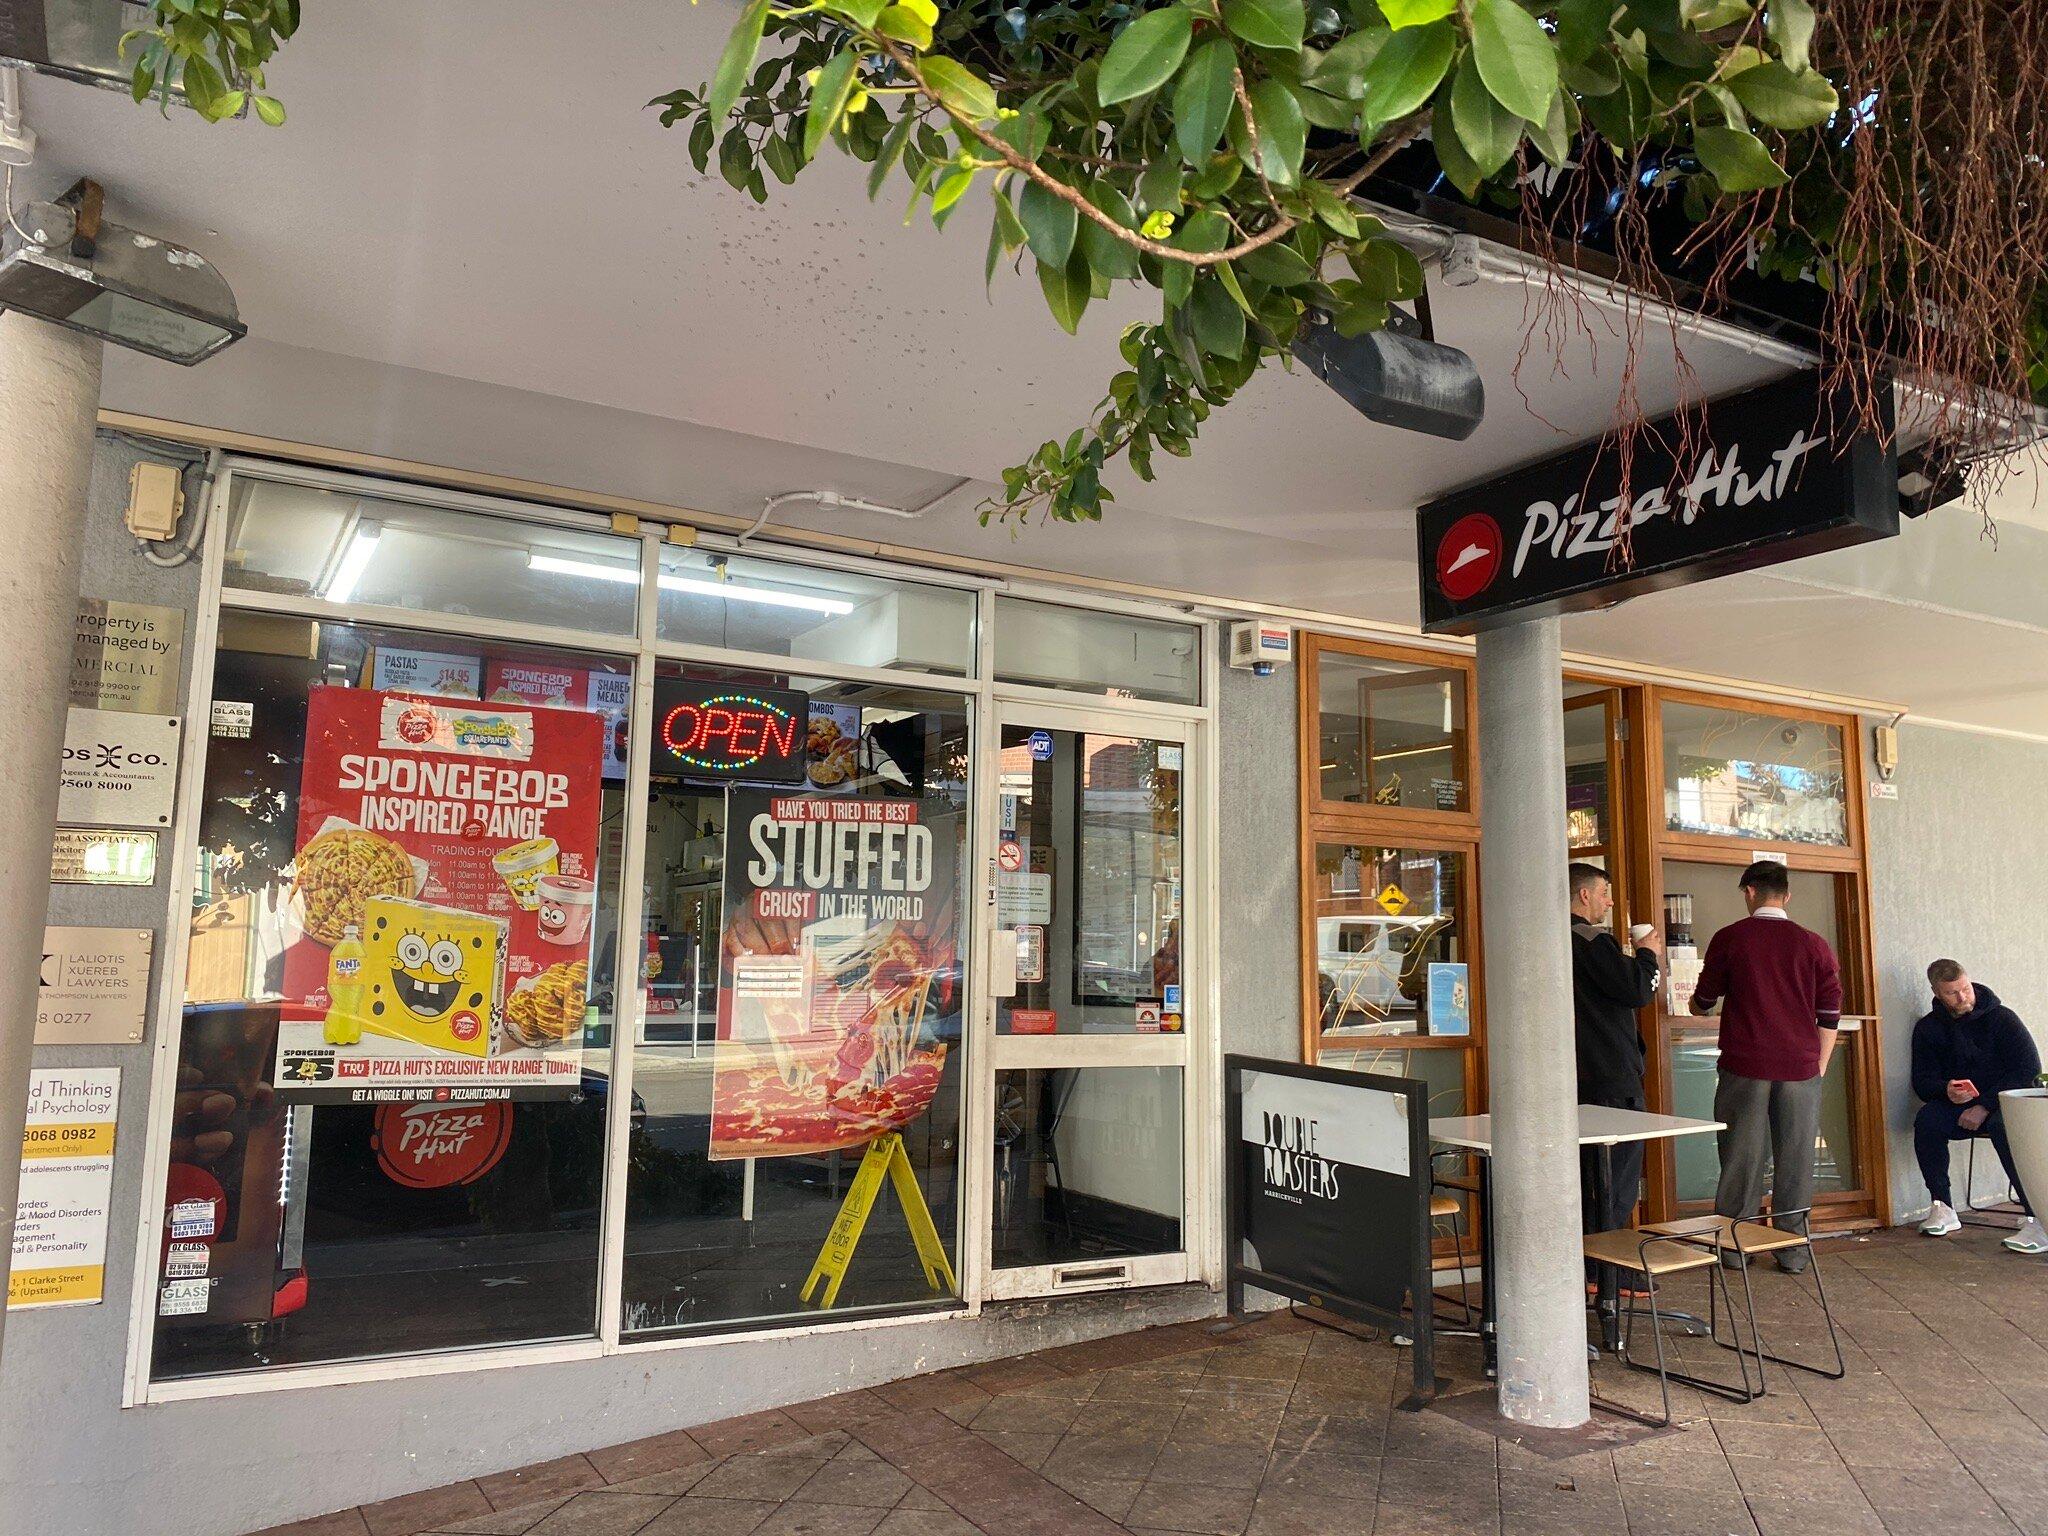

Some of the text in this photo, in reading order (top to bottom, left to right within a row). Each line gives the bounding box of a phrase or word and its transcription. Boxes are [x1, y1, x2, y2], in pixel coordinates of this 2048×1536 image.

[1513, 429, 1828, 579] Pizza Hut
[76, 615, 155, 633] roperty is
[77, 633, 171, 654] managed by
[384, 655, 418, 669] PASTAS
[501, 668, 572, 687] SPONGEBOB
[508, 681, 566, 697] INSPIRED RANGE
[597, 679, 629, 693] SHARED
[597, 690, 625, 704] MEALS
[214, 707, 251, 716] GLASS
[662, 705, 797, 758] OPEN
[464, 734, 508, 745] SQUAREPANTS
[1033, 741, 1049, 752] ADT
[61, 769, 91, 777] Agents
[103, 771, 155, 780] Accountants
[339, 754, 569, 808] SPONGEBOB
[97, 781, 132, 791] 8000
[777, 801, 910, 821] HAVE YOU TRIED THE BEST
[360, 796, 548, 840] INSPIRED RANGE
[54, 834, 140, 844] and ASSOCIATES
[431, 845, 475, 856] TRADING
[747, 813, 933, 892] STUFFED
[479, 861, 486, 869] to
[448, 871, 477, 879] 11.00am
[479, 871, 485, 879] to
[478, 882, 484, 890] to
[760, 891, 923, 921] CRUST IN THE WORLD
[69, 954, 125, 963] LALIOTIS
[69, 966, 118, 976] XUEREB
[67, 979, 129, 988] LAWYERS
[53, 1013, 92, 1024] 0277
[283, 1057, 335, 1080] 25
[342, 1059, 577, 1076] TRY PIZZA HUT'S EXCLUSIVE NEW RANGE TODAY!
[28, 1080, 112, 1098] d Thinking
[352, 1088, 511, 1101] GET A WIGGLE ON! VISIT PIZZAHUT.COM.AU
[42, 1099, 111, 1115] Psychology
[62, 1128, 96, 1140] 0982
[400, 1113, 485, 1151] Pizza
[1263, 1110, 1319, 1157] DOUBLE
[413, 1132, 474, 1164] Hut
[29, 1164, 72, 1174] adolescents
[73, 1163, 110, 1172] struggling
[1263, 1146, 1339, 1200] ROASTERS
[1264, 1190, 1303, 1204] MARRICKVILLE
[18, 1200, 48, 1209] orders
[19, 1208, 102, 1219] & Mood Disorders
[27, 1244, 34, 1253] &
[36, 1242, 88, 1252] Personality
[182, 1243, 206, 1251] GLASS
[29, 1276, 56, 1285] Clarke
[58, 1274, 84, 1283] Street
[20, 1286, 62, 1297] (Upstairs)
[162, 1286, 208, 1299] GLASS
